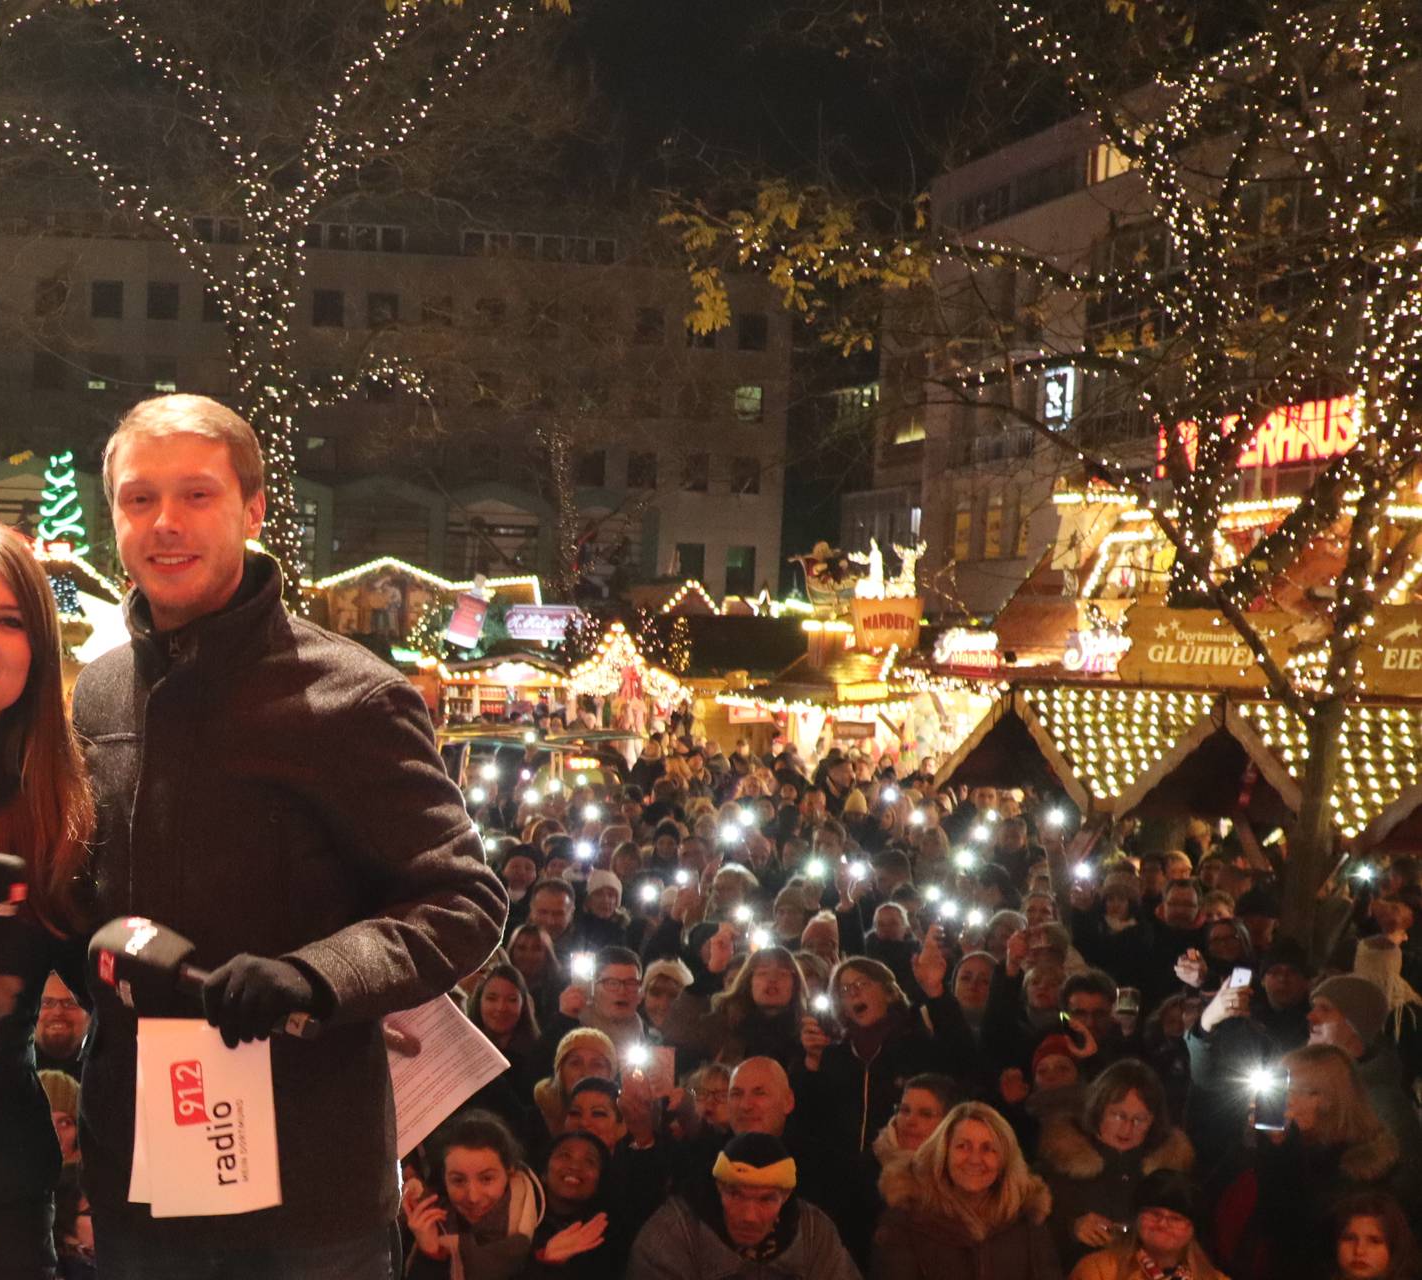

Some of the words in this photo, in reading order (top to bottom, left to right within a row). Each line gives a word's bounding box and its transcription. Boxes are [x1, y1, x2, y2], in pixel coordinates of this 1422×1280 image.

[1148, 641, 1255, 666] GLÜHWEI
[175, 1062, 204, 1117] 91.2
[206, 1101, 238, 1187] radio
